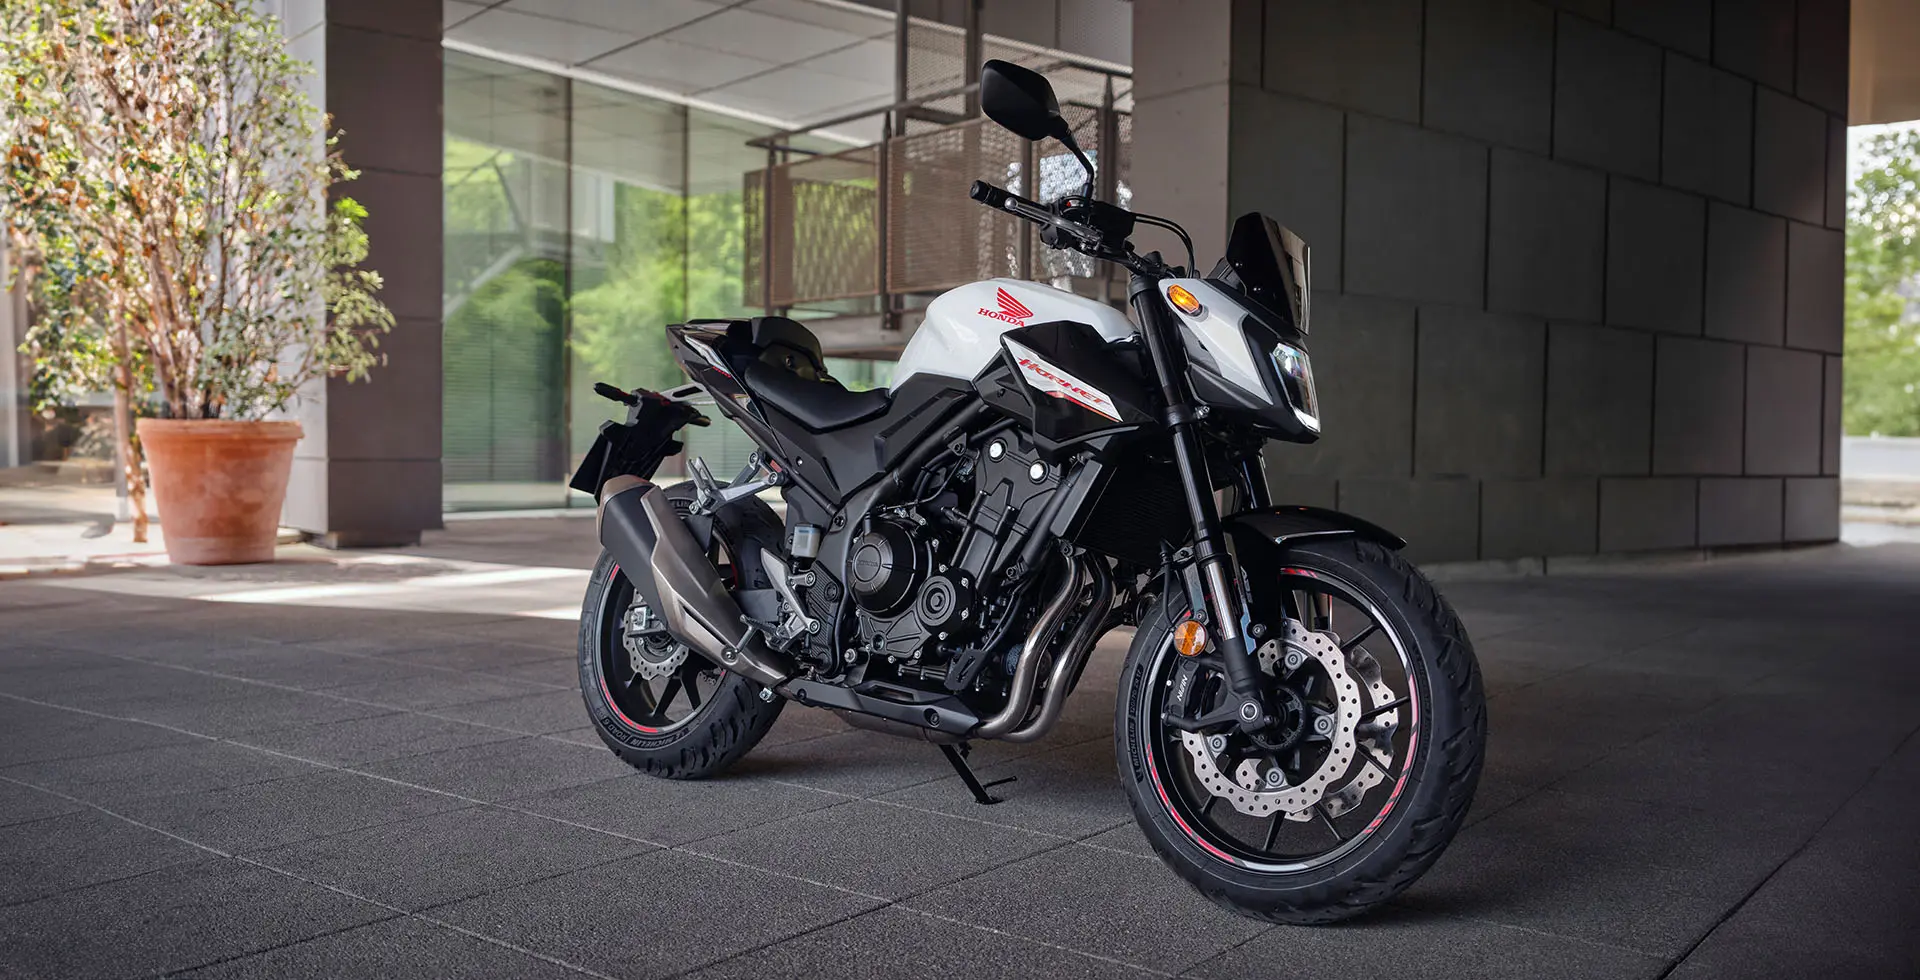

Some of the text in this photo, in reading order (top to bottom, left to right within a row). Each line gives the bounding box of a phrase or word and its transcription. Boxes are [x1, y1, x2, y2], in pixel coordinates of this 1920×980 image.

[978, 308, 1025, 327] HONDA
[1018, 358, 1110, 405] HORNET
[608, 725, 628, 741] ROAD
[630, 737, 674, 748] MICHELIN
[1129, 721, 1140, 767] MICHELIN
